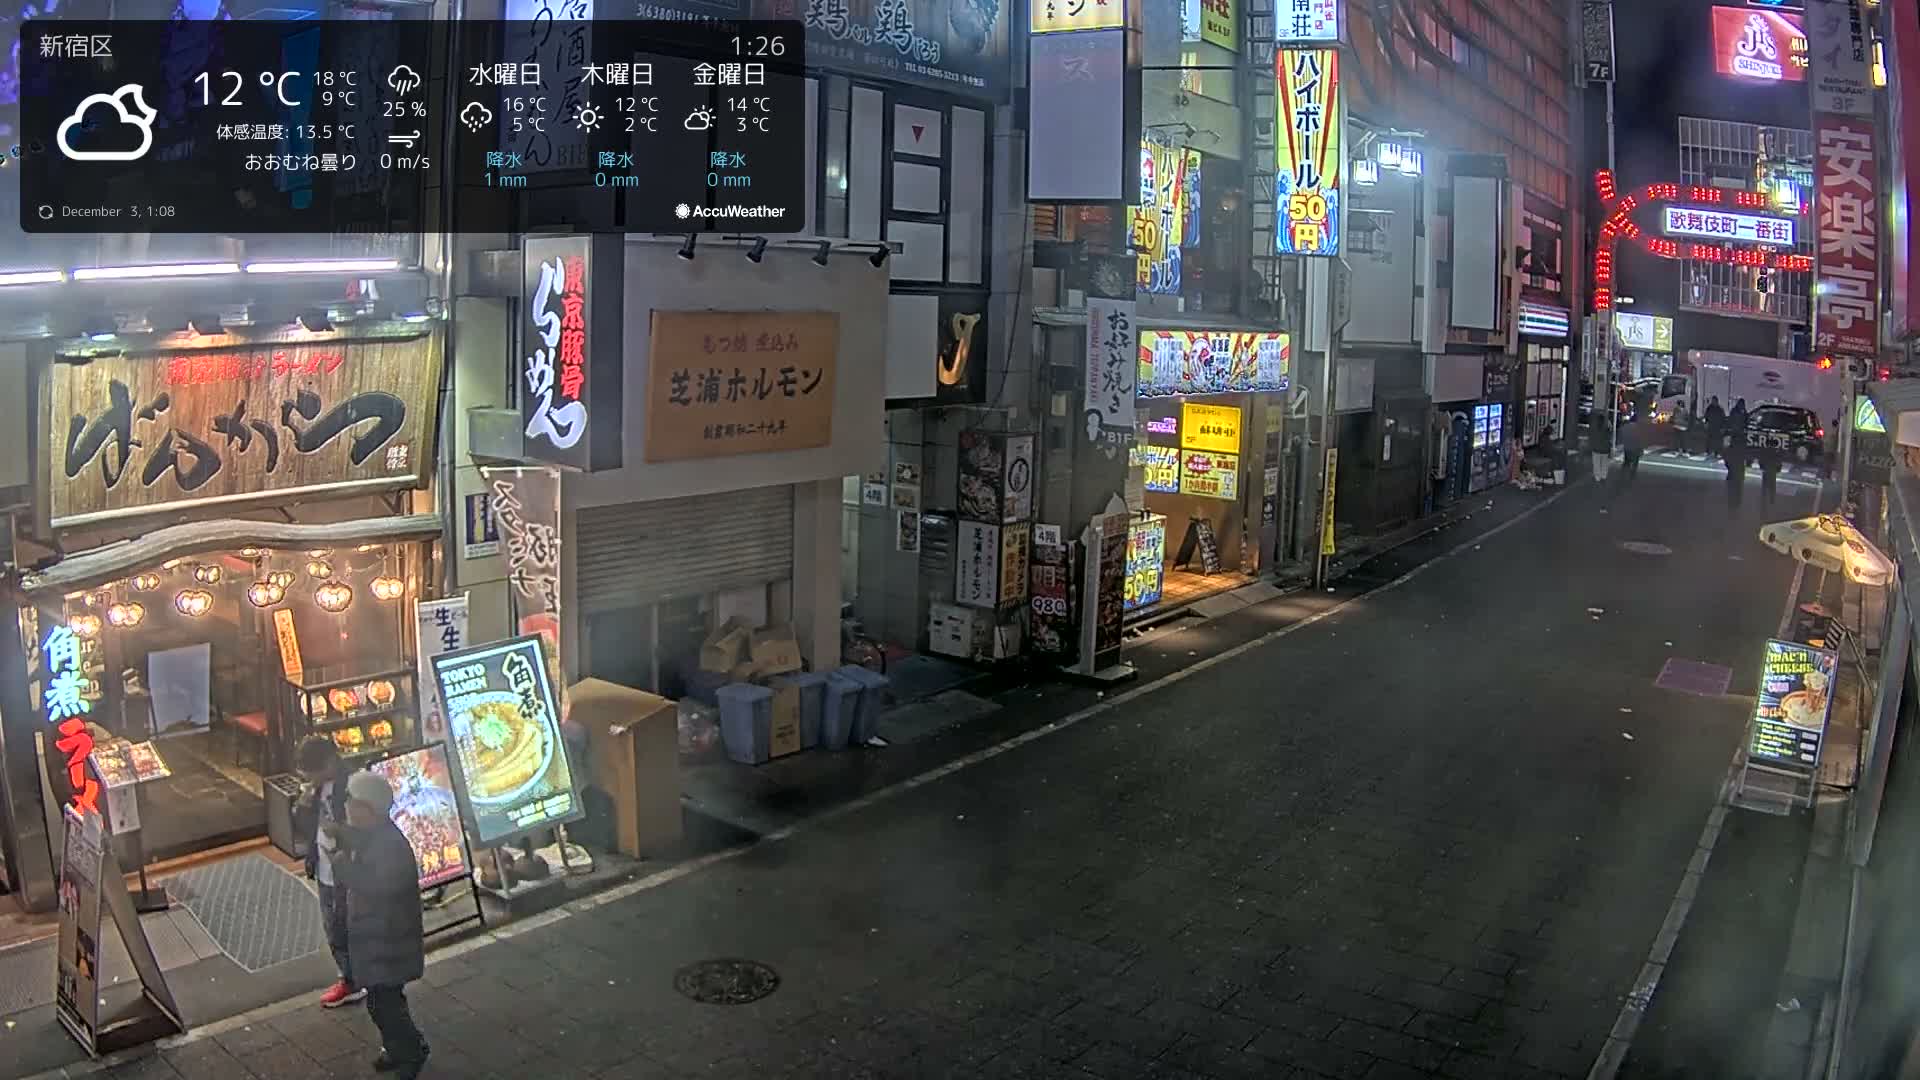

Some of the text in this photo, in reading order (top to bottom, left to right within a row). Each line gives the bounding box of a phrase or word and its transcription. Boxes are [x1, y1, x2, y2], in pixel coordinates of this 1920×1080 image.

[1295, 53, 1320, 190] ハイボール
[1669, 210, 1789, 242] 歌舞伎町一番街
[1819, 126, 1875, 329] 安楽亭
[561, 256, 585, 400] 東京豚骨
[1817, 332, 1836, 347] 2F
[1102, 310, 1132, 414] お好み焼き
[669, 364, 823, 407] 芝浦ホルモン
[1746, 433, 1791, 450] S.RDE
[1038, 530, 1056, 544] 4階
[441, 663, 485, 684] TOKYO
[445, 676, 488, 697] RAMEN
[507, 656, 544, 719] 角煮
